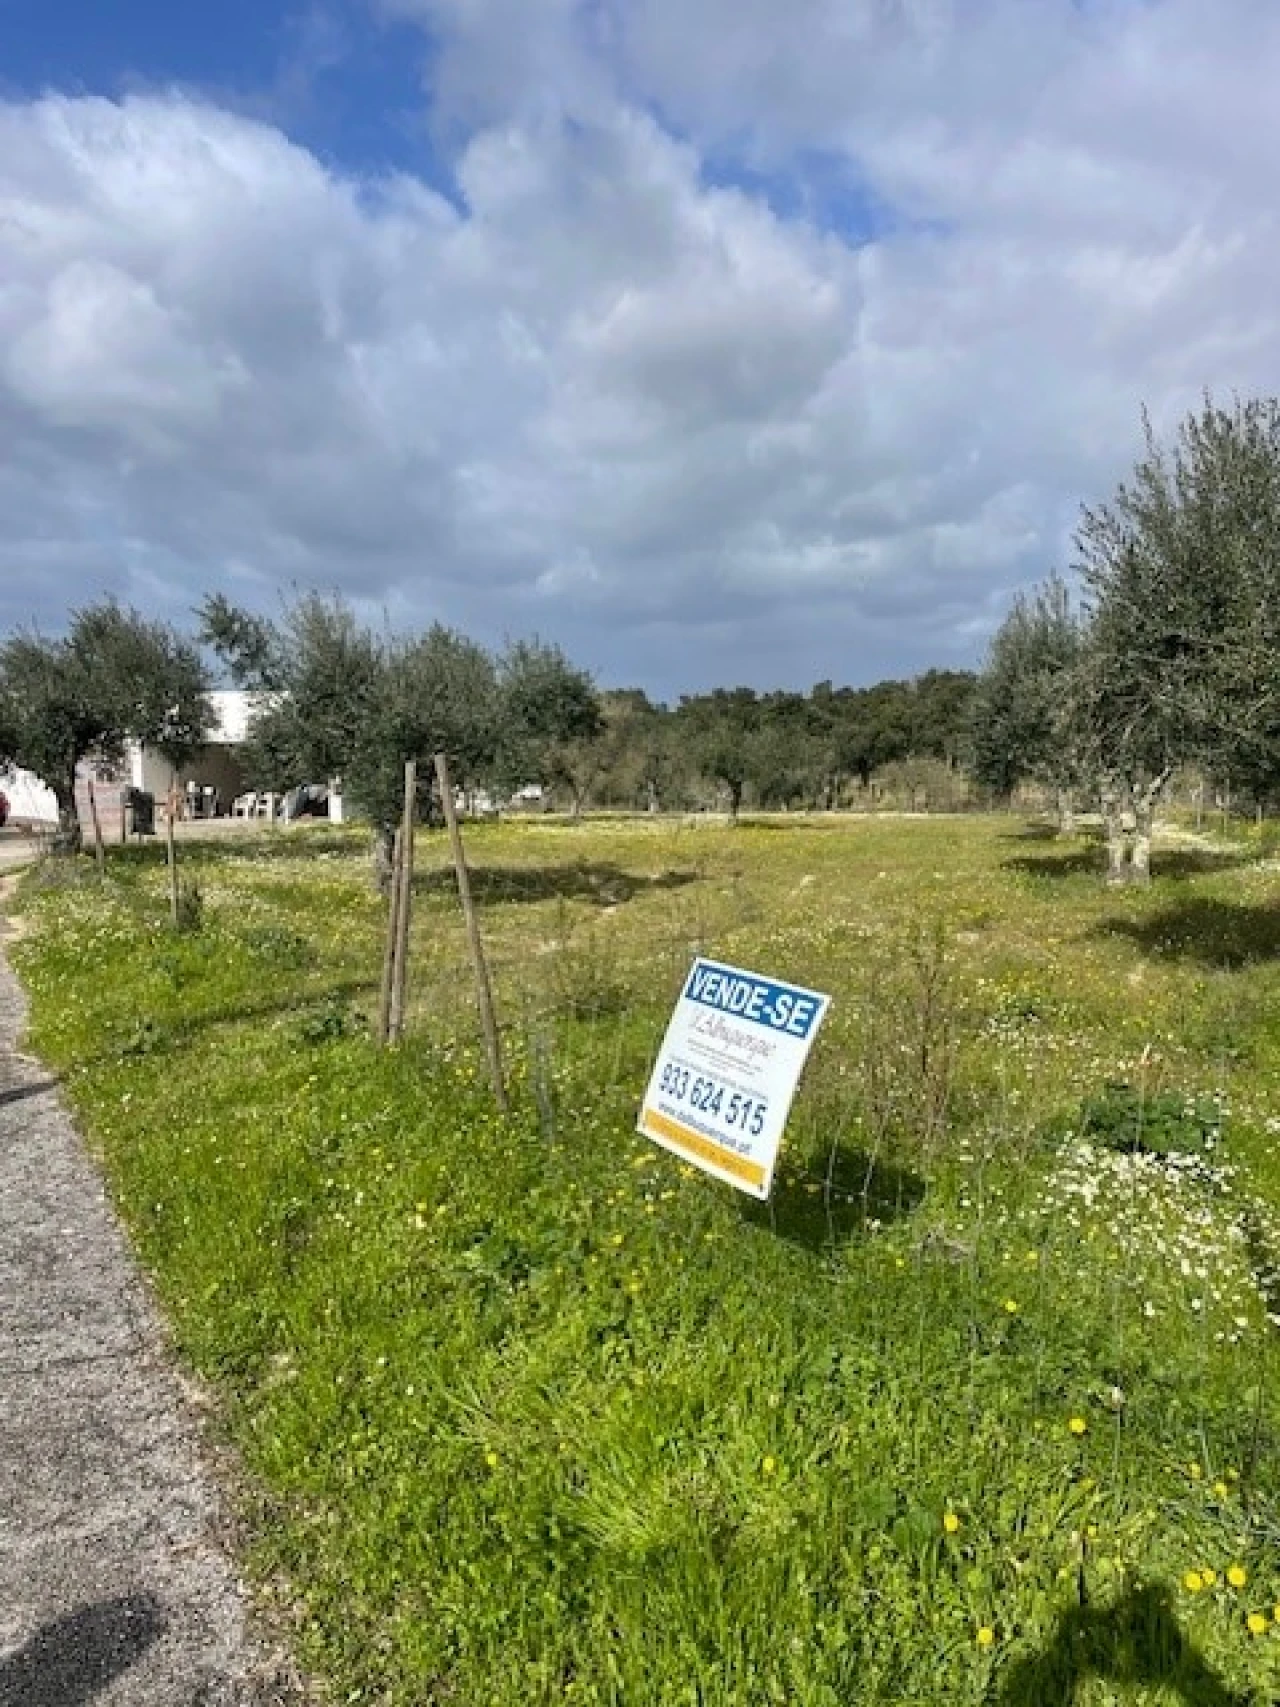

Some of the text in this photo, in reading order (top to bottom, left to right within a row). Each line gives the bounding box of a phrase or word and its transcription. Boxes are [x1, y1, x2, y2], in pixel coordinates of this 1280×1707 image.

[692, 967, 815, 1034] VENDE-SE
[659, 1063, 690, 1100] 933
[690, 1077, 725, 1116] 624
[725, 1093, 768, 1136] 515
